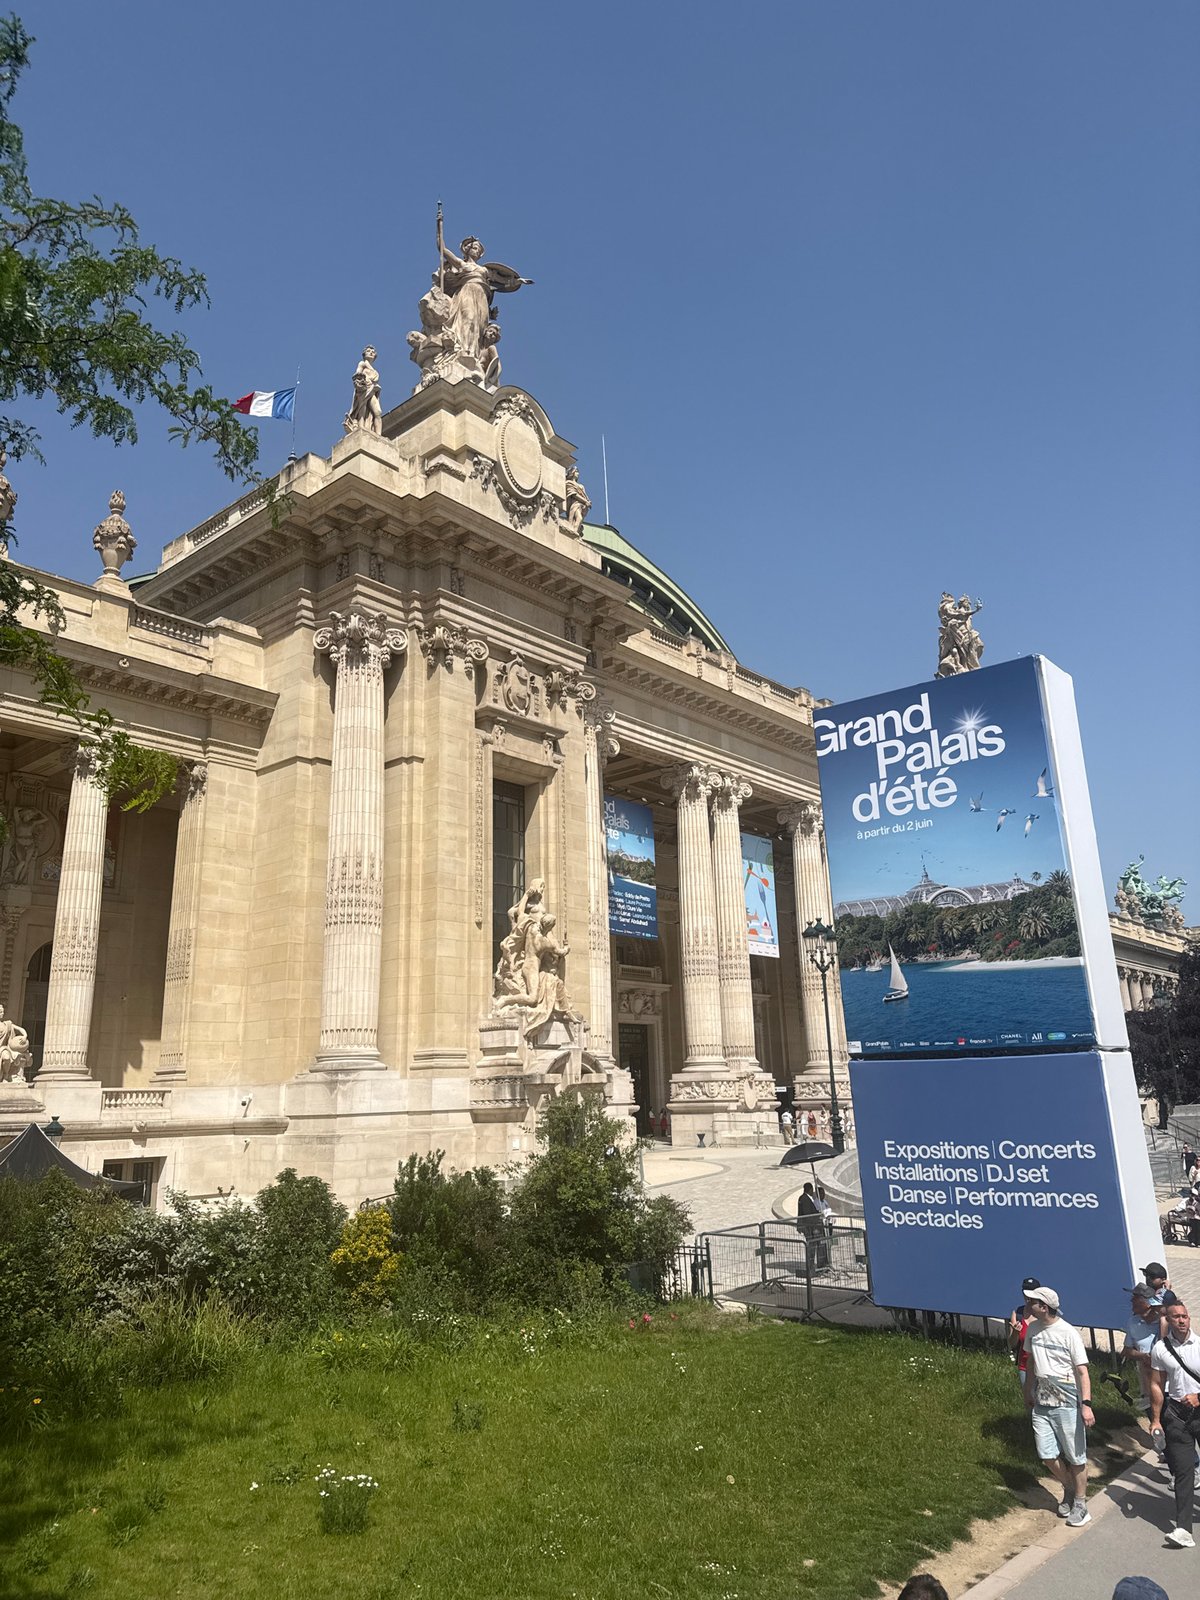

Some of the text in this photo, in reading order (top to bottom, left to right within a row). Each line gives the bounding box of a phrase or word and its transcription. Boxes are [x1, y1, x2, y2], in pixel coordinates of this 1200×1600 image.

[813, 692, 933, 757] Grand
[876, 724, 1006, 779] Palais
[852, 767, 958, 823] d'été
[856, 819, 933, 840] à partir du 2 juin
[884, 1140, 1096, 1162] Expositions Concerts
[874, 1162, 1050, 1183] Installations DJ set
[888, 1184, 1099, 1209] Danse Performances
[880, 1206, 984, 1229] Spectacles
